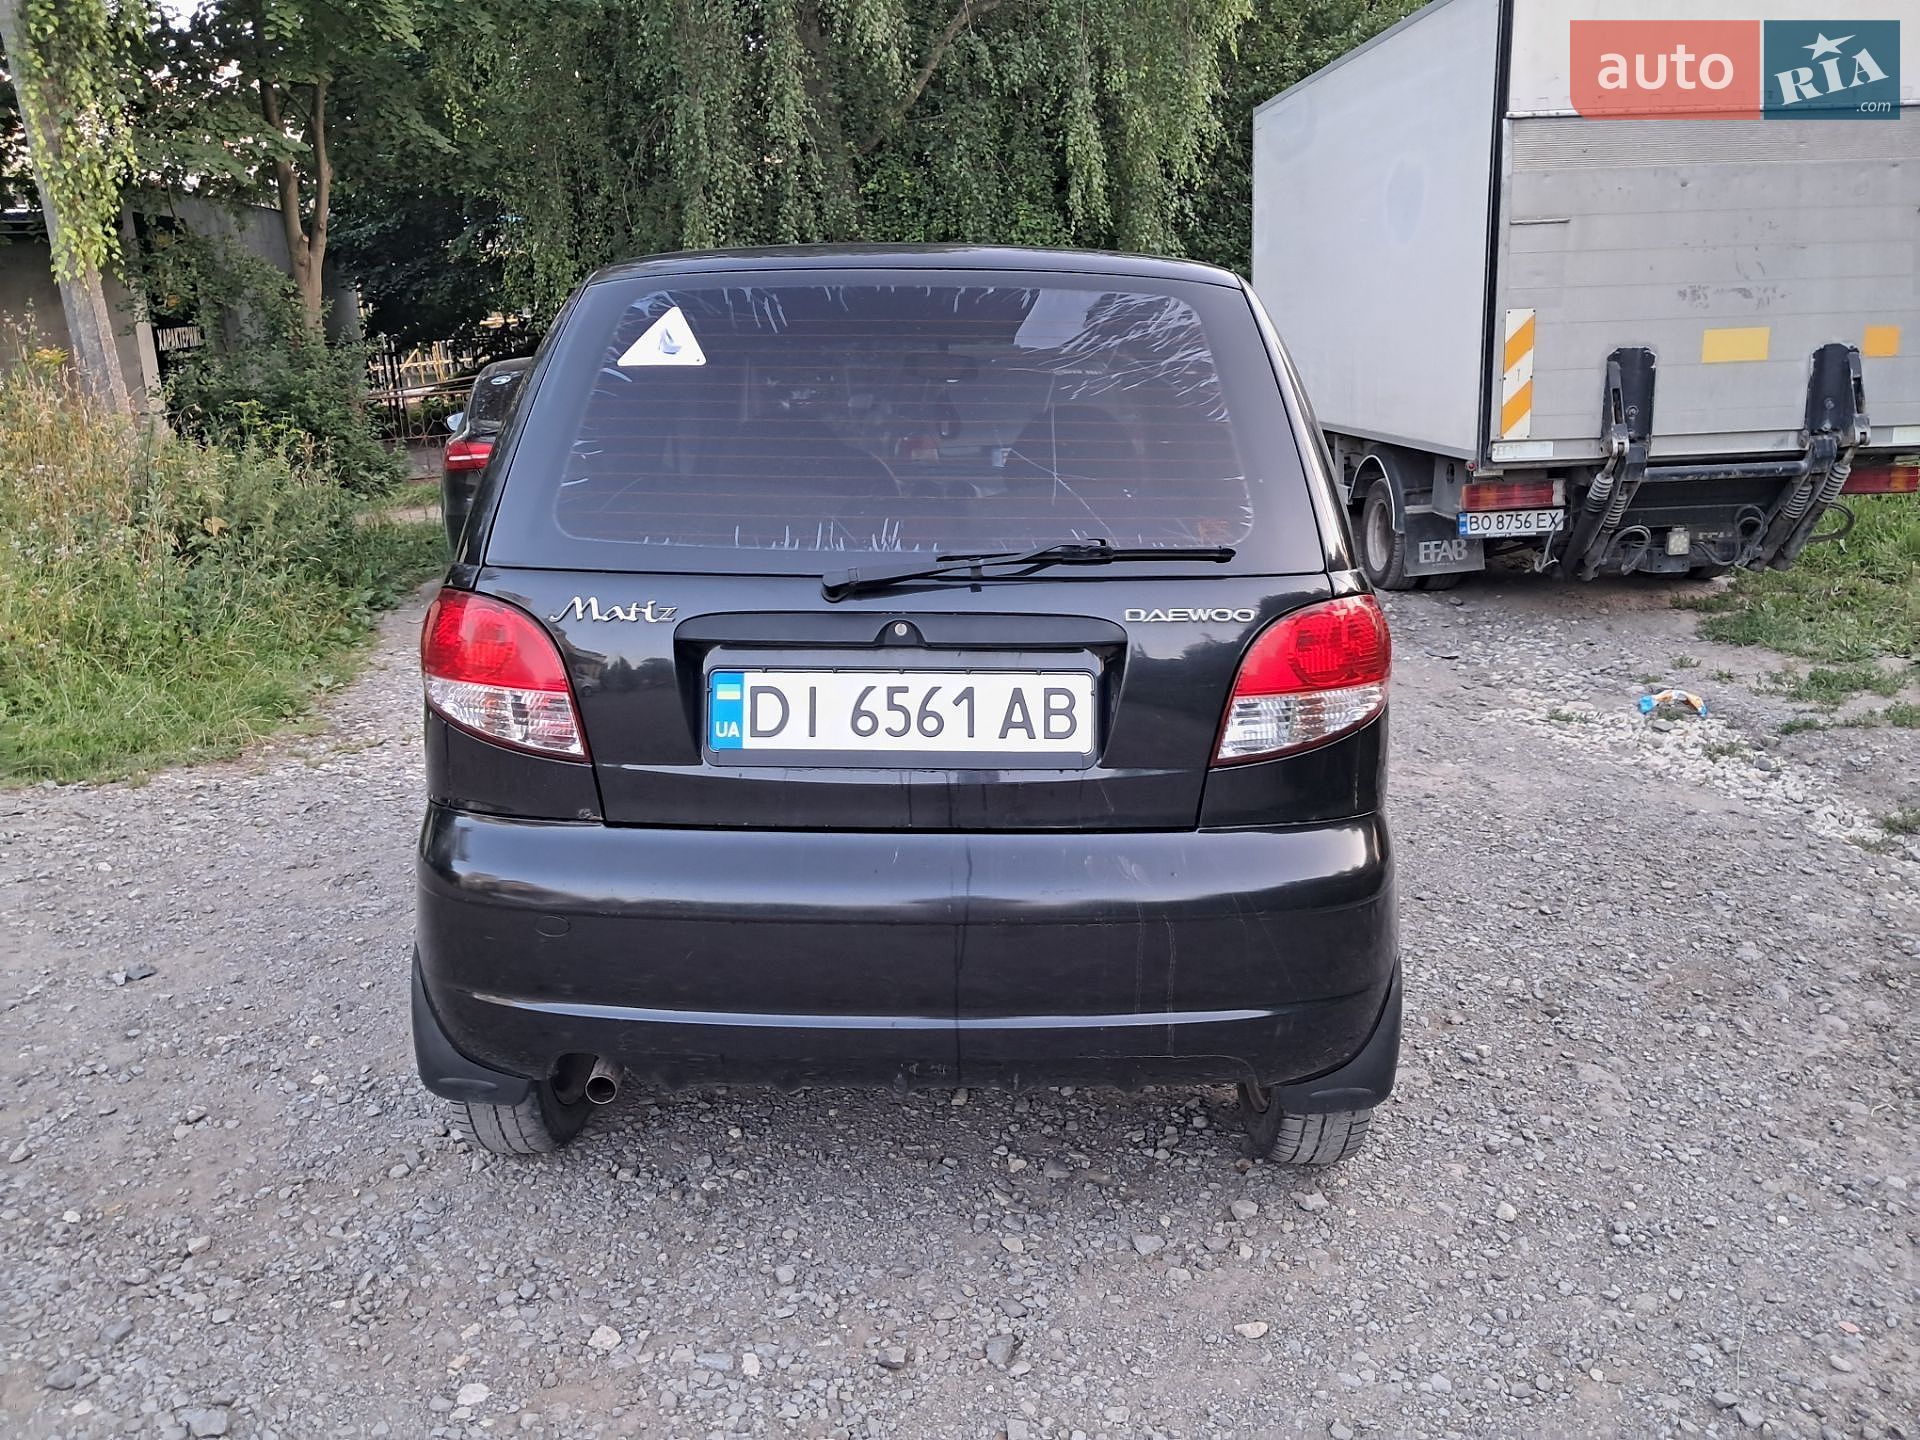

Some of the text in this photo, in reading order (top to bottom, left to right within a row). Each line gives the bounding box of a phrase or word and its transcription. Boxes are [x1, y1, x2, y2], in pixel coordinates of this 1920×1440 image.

[1469, 511, 1559, 531] BO 8756 EX
[550, 596, 677, 622] Matiz
[1125, 608, 1256, 622] DAEWOO
[750, 685, 1078, 740] DI 6561 AB
[715, 721, 740, 738] UA
